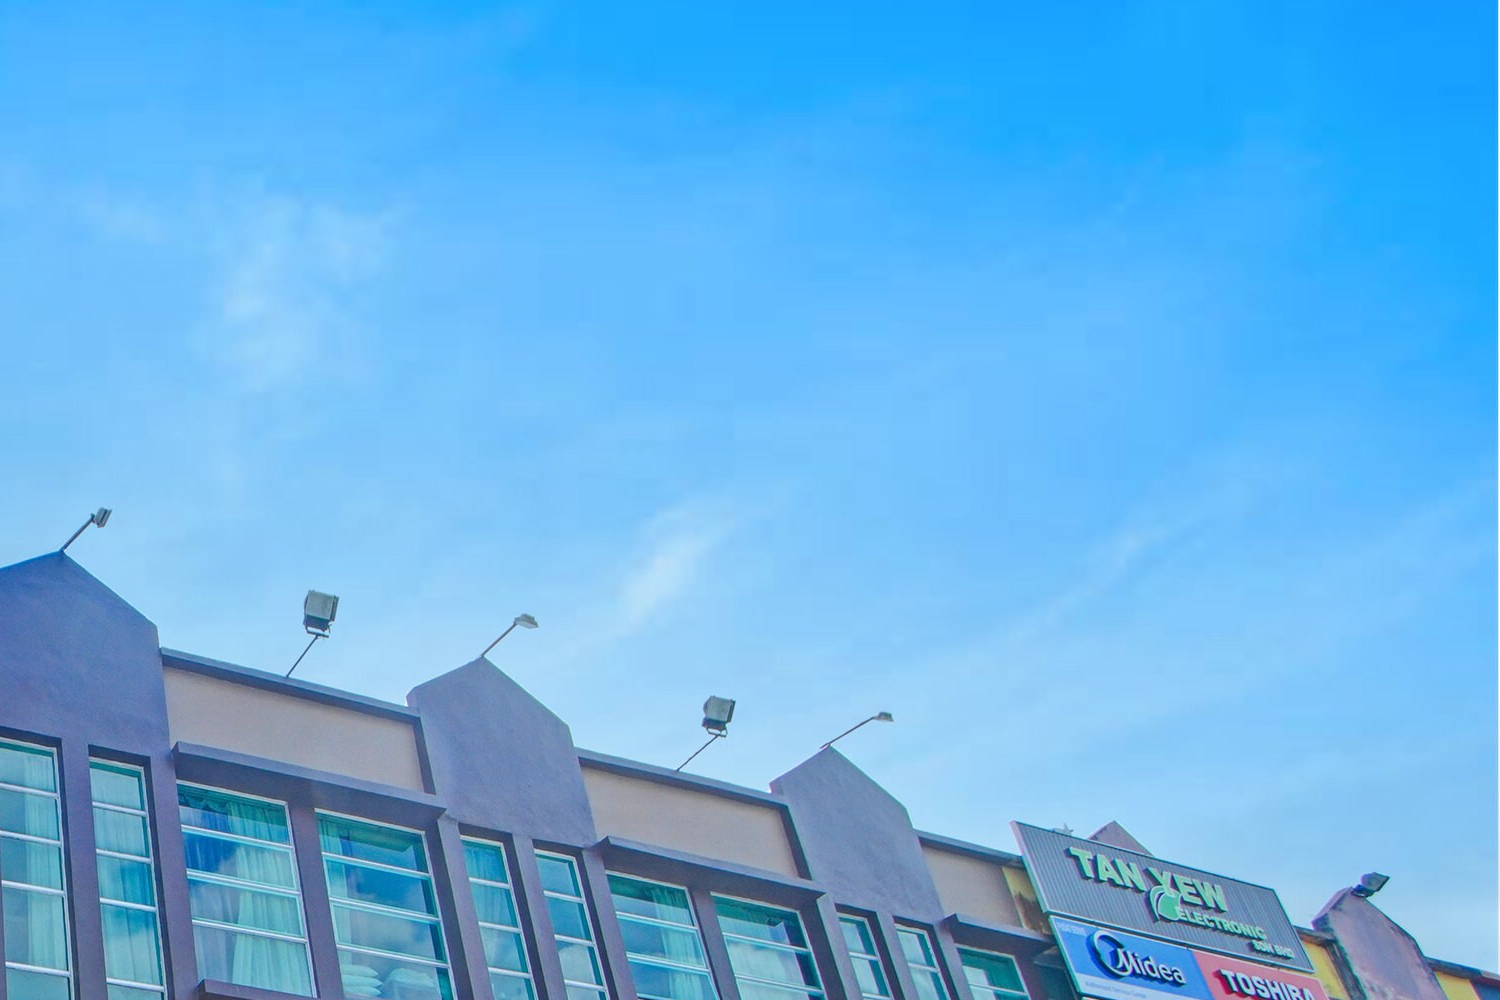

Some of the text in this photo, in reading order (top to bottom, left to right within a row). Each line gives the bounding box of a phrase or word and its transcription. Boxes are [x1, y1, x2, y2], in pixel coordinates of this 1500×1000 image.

[1067, 846, 1228, 912] TAN YEW
[1176, 905, 1267, 941] ELECTRONIC
[1100, 936, 1187, 985] Midea
